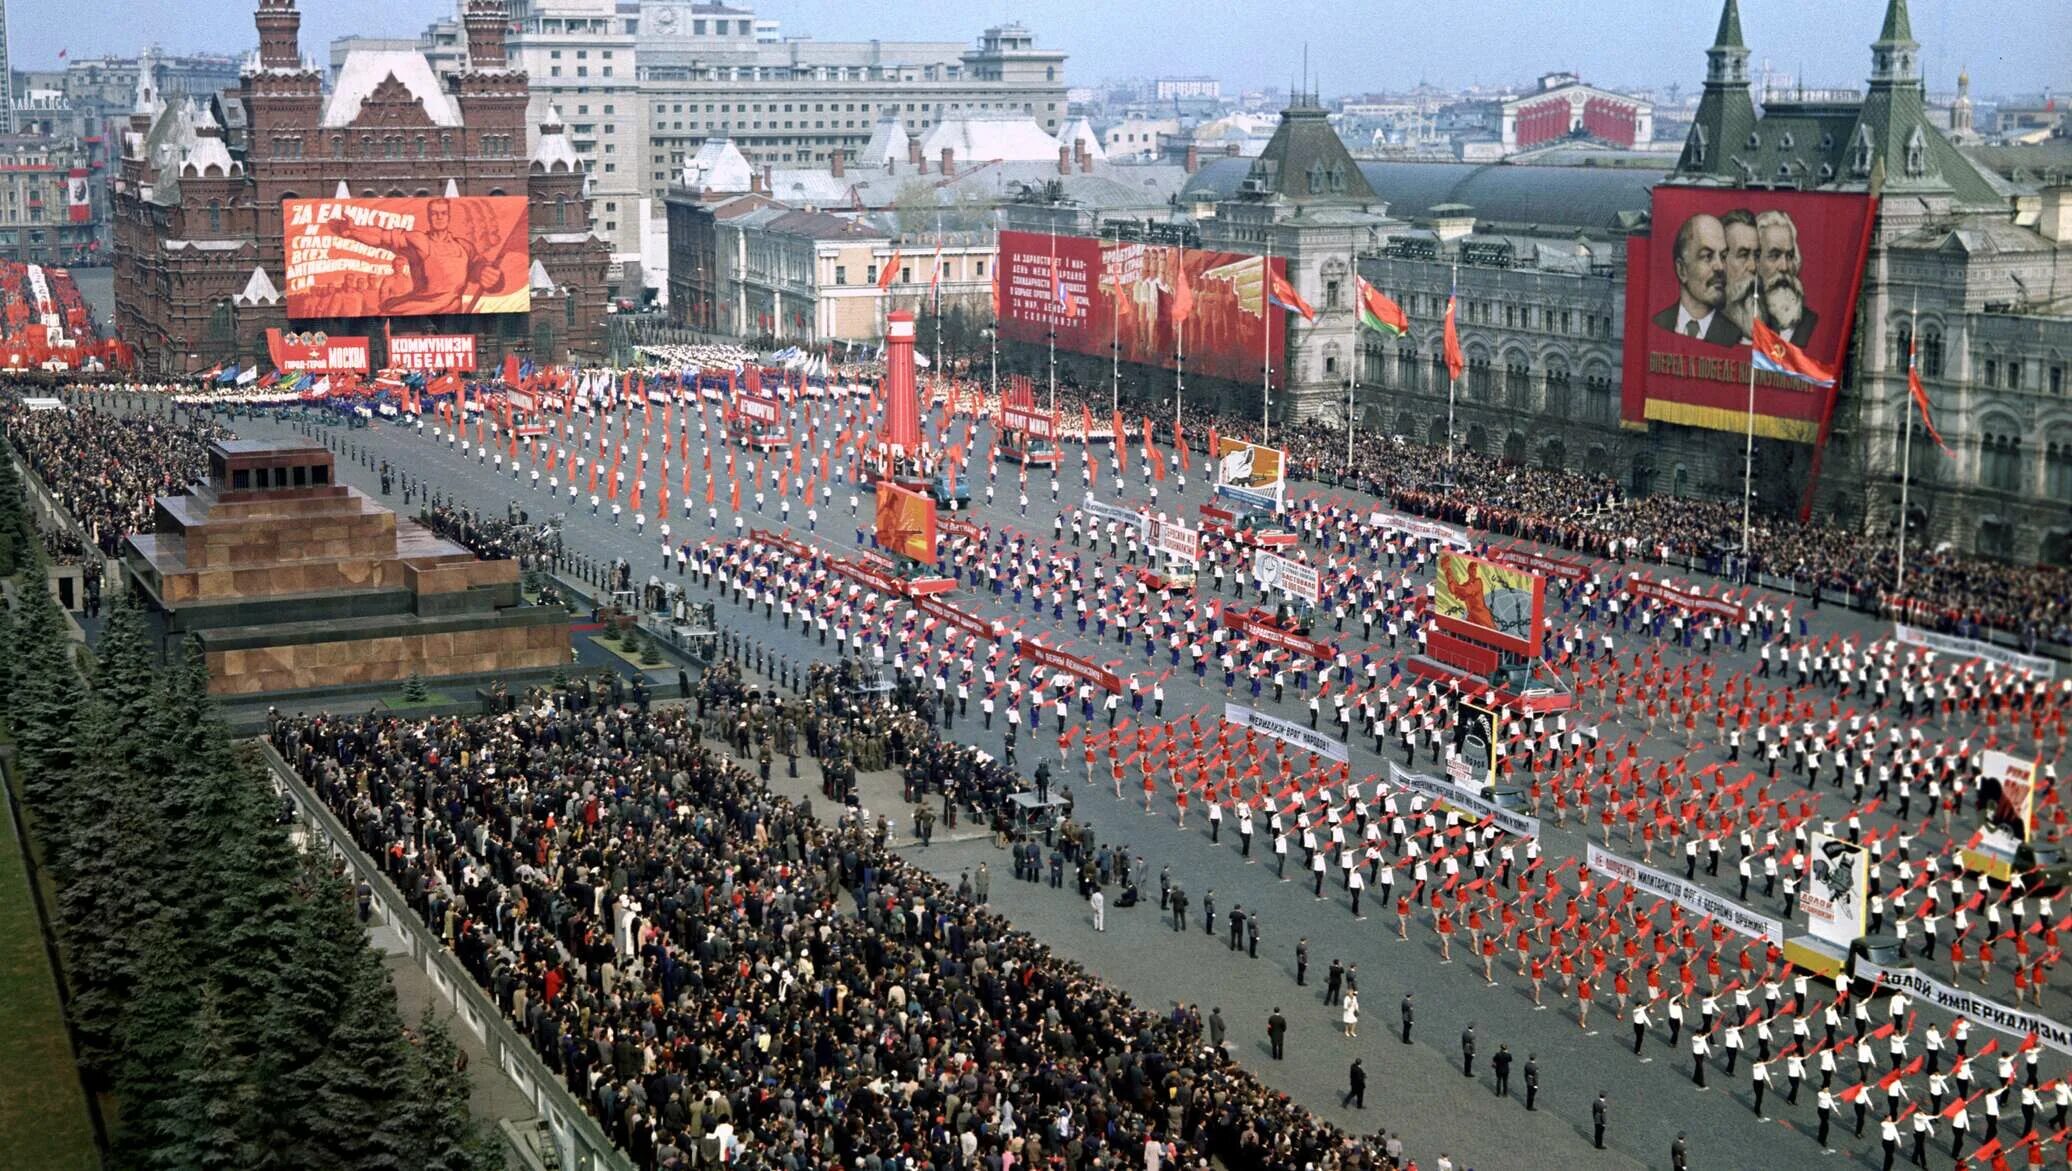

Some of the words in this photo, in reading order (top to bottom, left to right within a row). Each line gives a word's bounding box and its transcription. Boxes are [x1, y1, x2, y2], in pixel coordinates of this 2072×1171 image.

[290, 204, 313, 225] ЗА
[291, 249, 329, 265] ВСЕХ
[1022, 253, 1062, 267] ЗДРАВСТВЕТ
[391, 337, 472, 353] КОММУНИЗМ
[328, 346, 366, 369] МОСКВА
[1881, 970, 1932, 999] ДОЛОЙ
